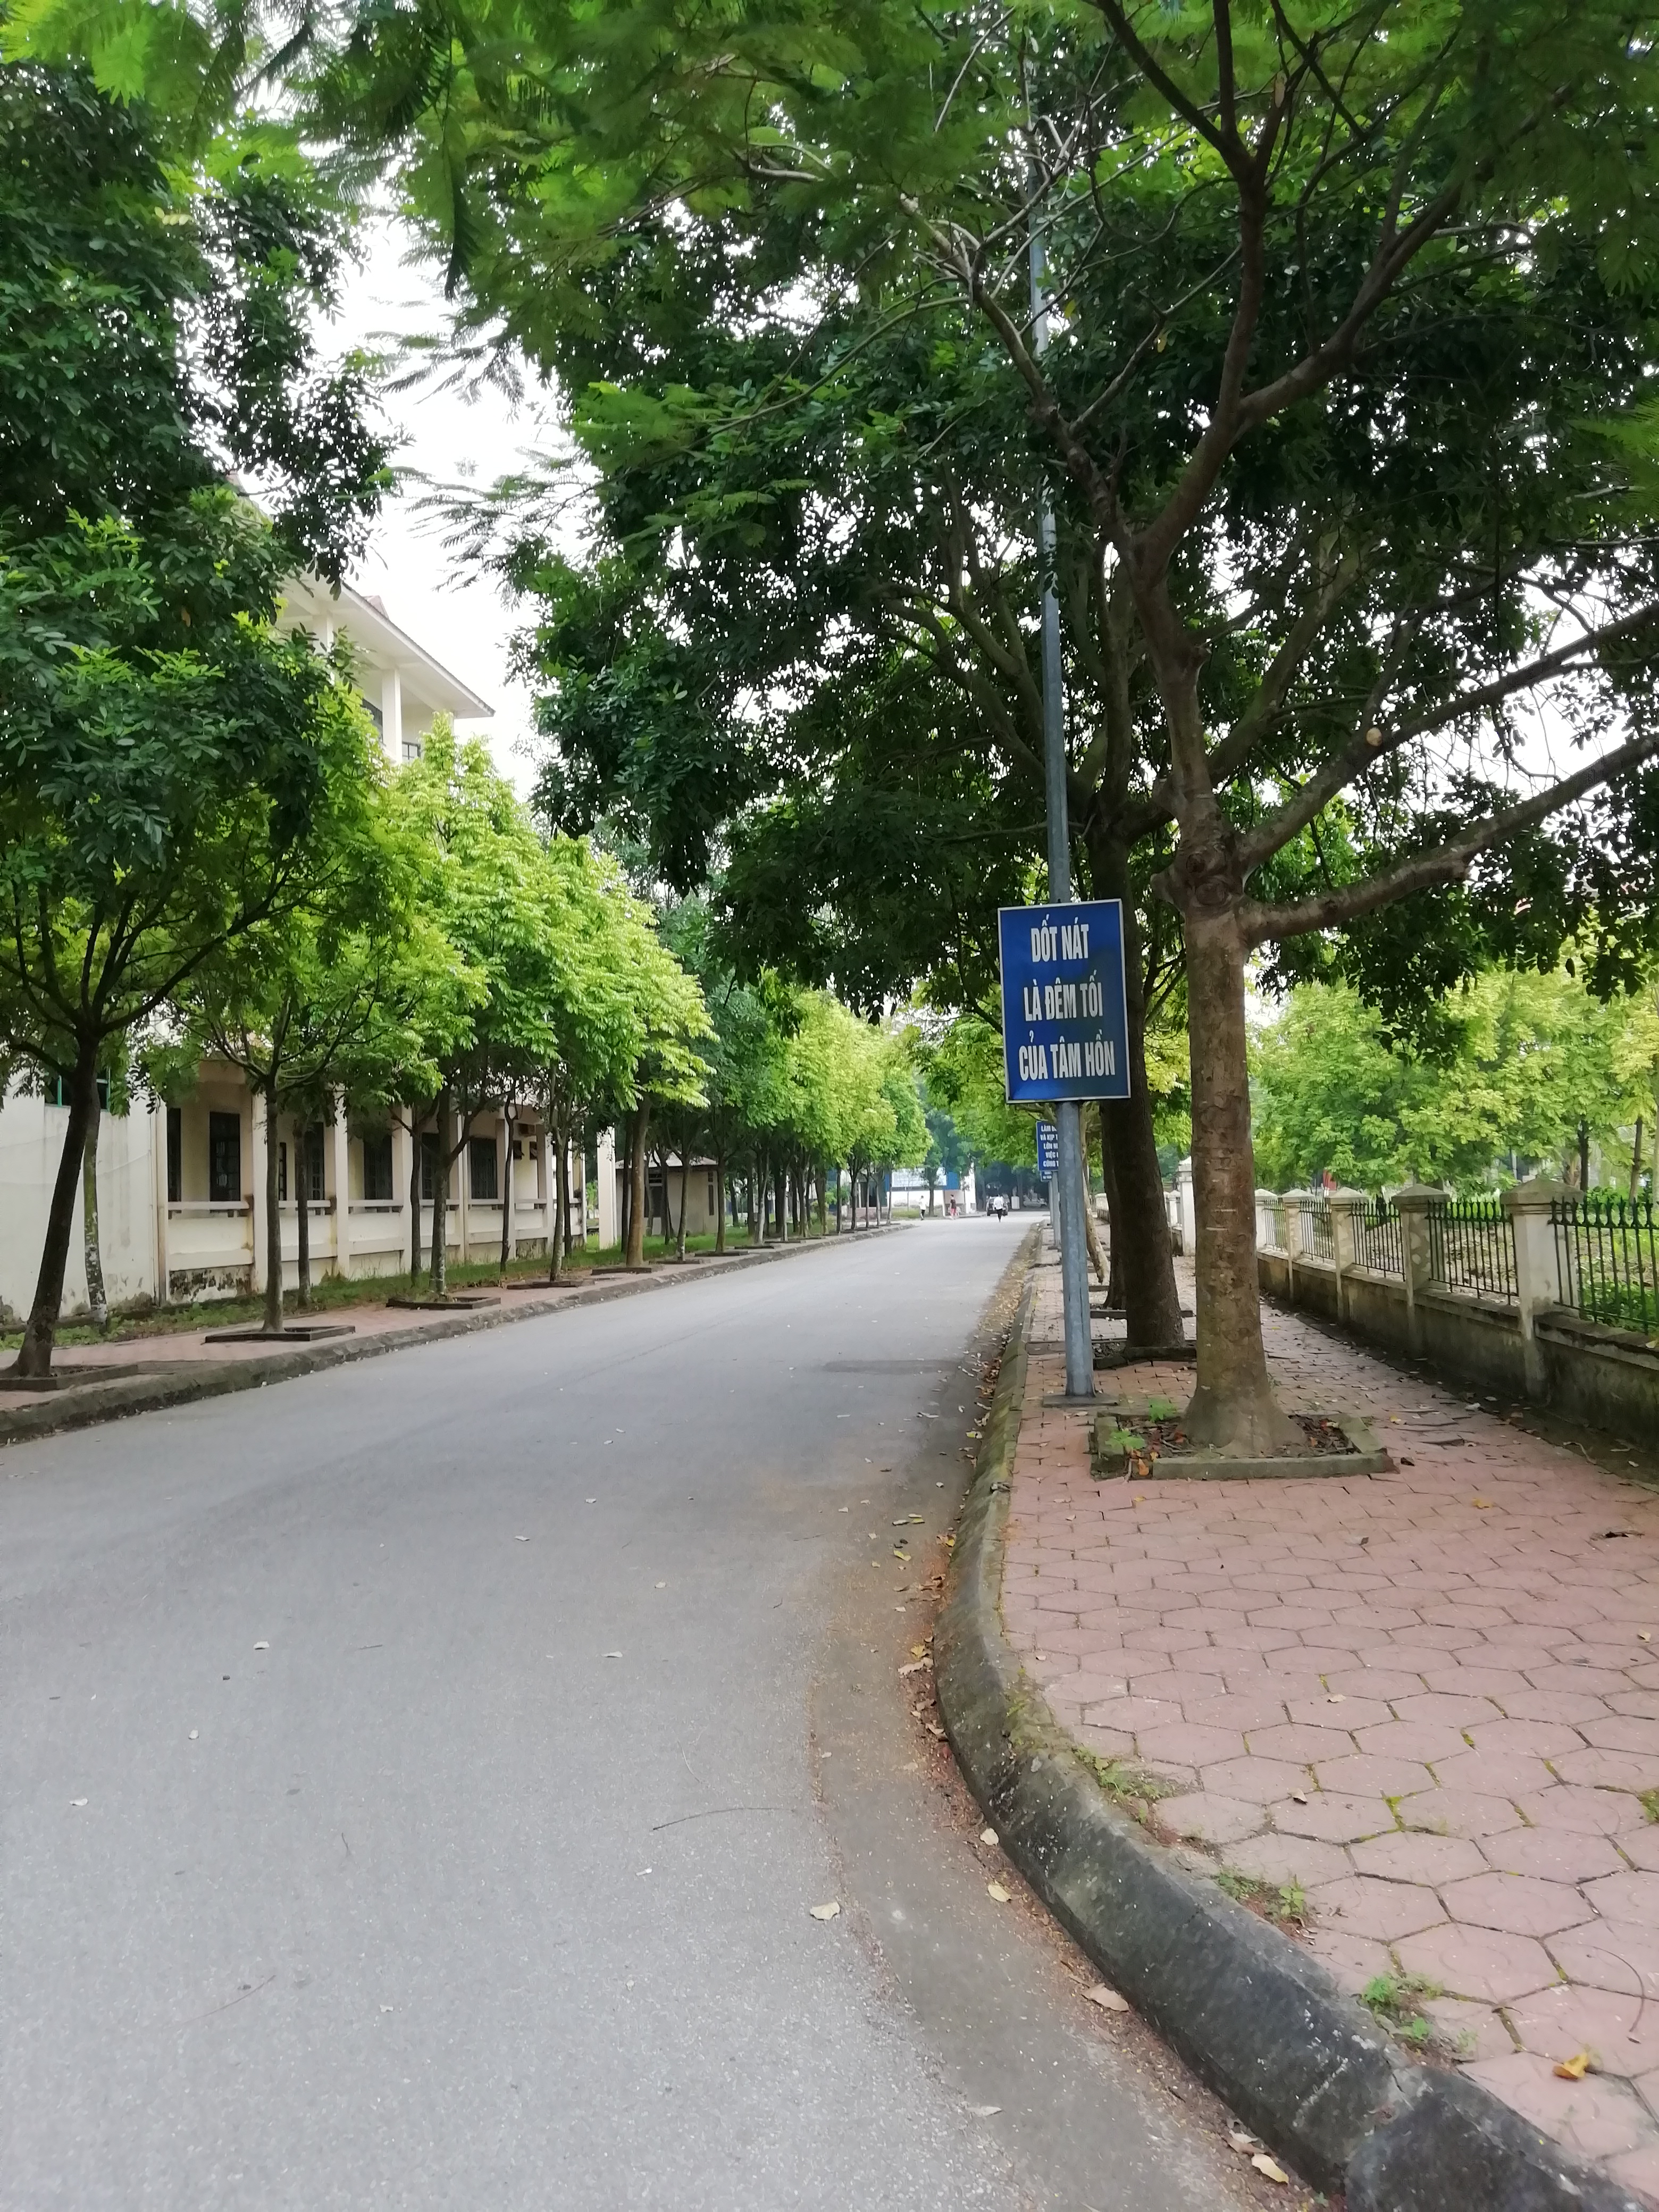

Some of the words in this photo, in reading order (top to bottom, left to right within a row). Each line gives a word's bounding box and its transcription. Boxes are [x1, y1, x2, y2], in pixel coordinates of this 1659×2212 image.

[1030, 914, 1057, 962] DỐT
[1061, 917, 1089, 960] NÁT
[1024, 978, 1042, 1021] LÀ
[1045, 977, 1077, 1020] ĐÊM
[1080, 969, 1103, 1018] TỐI
[1019, 1030, 1049, 1081] CỦA
[1050, 1035, 1082, 1079] TÂM
[1085, 1029, 1116, 1077] HỒN
